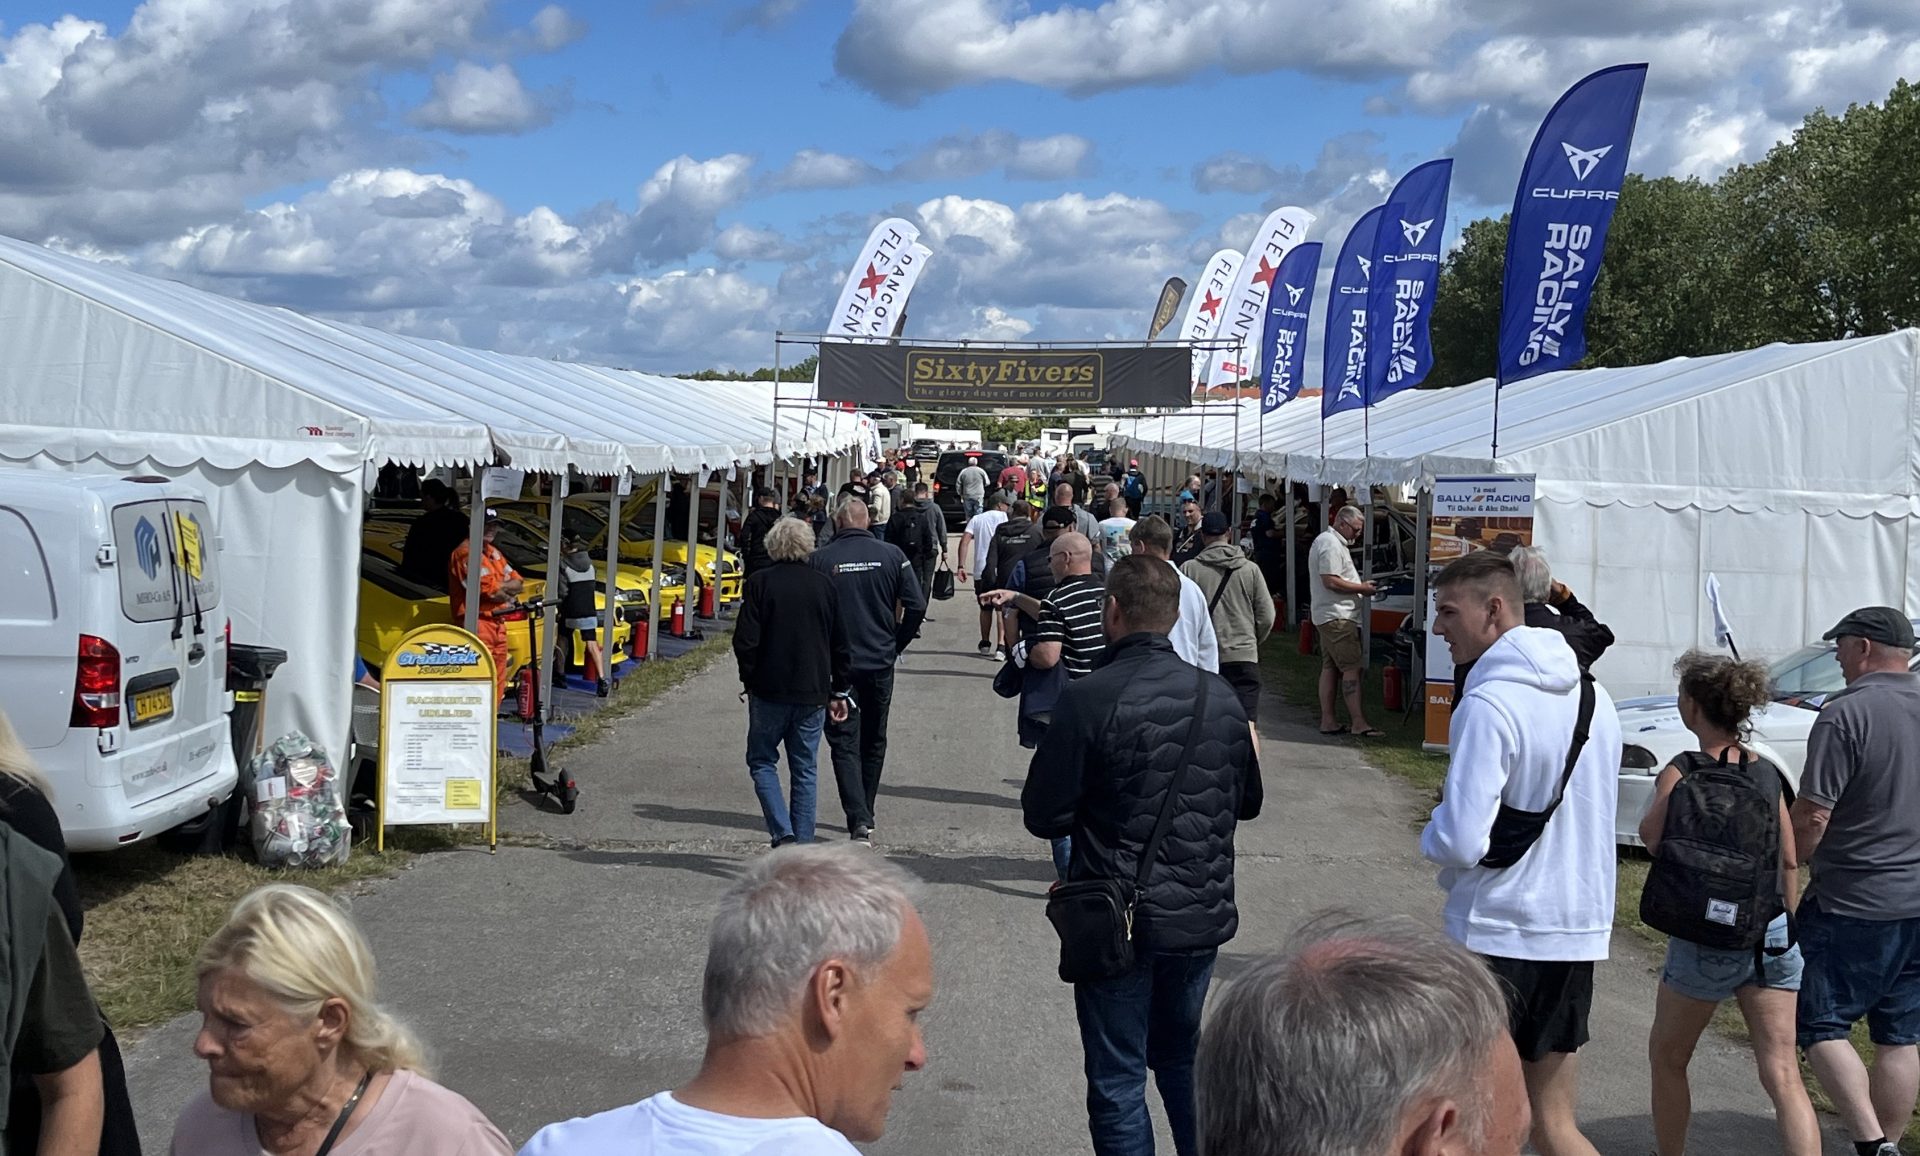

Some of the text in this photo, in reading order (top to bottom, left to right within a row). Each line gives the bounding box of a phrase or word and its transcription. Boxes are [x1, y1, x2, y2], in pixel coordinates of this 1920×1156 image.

[843, 227, 902, 343] FLEXTEN
[1518, 222, 1569, 367] RACING
[1546, 225, 1593, 337] SALLY
[913, 357, 1095, 387] SixtyFivers
[913, 387, 1094, 400] The glory days of motor racing
[1437, 494, 1531, 503] SALLY RACING
[1477, 504, 1484, 512] &
